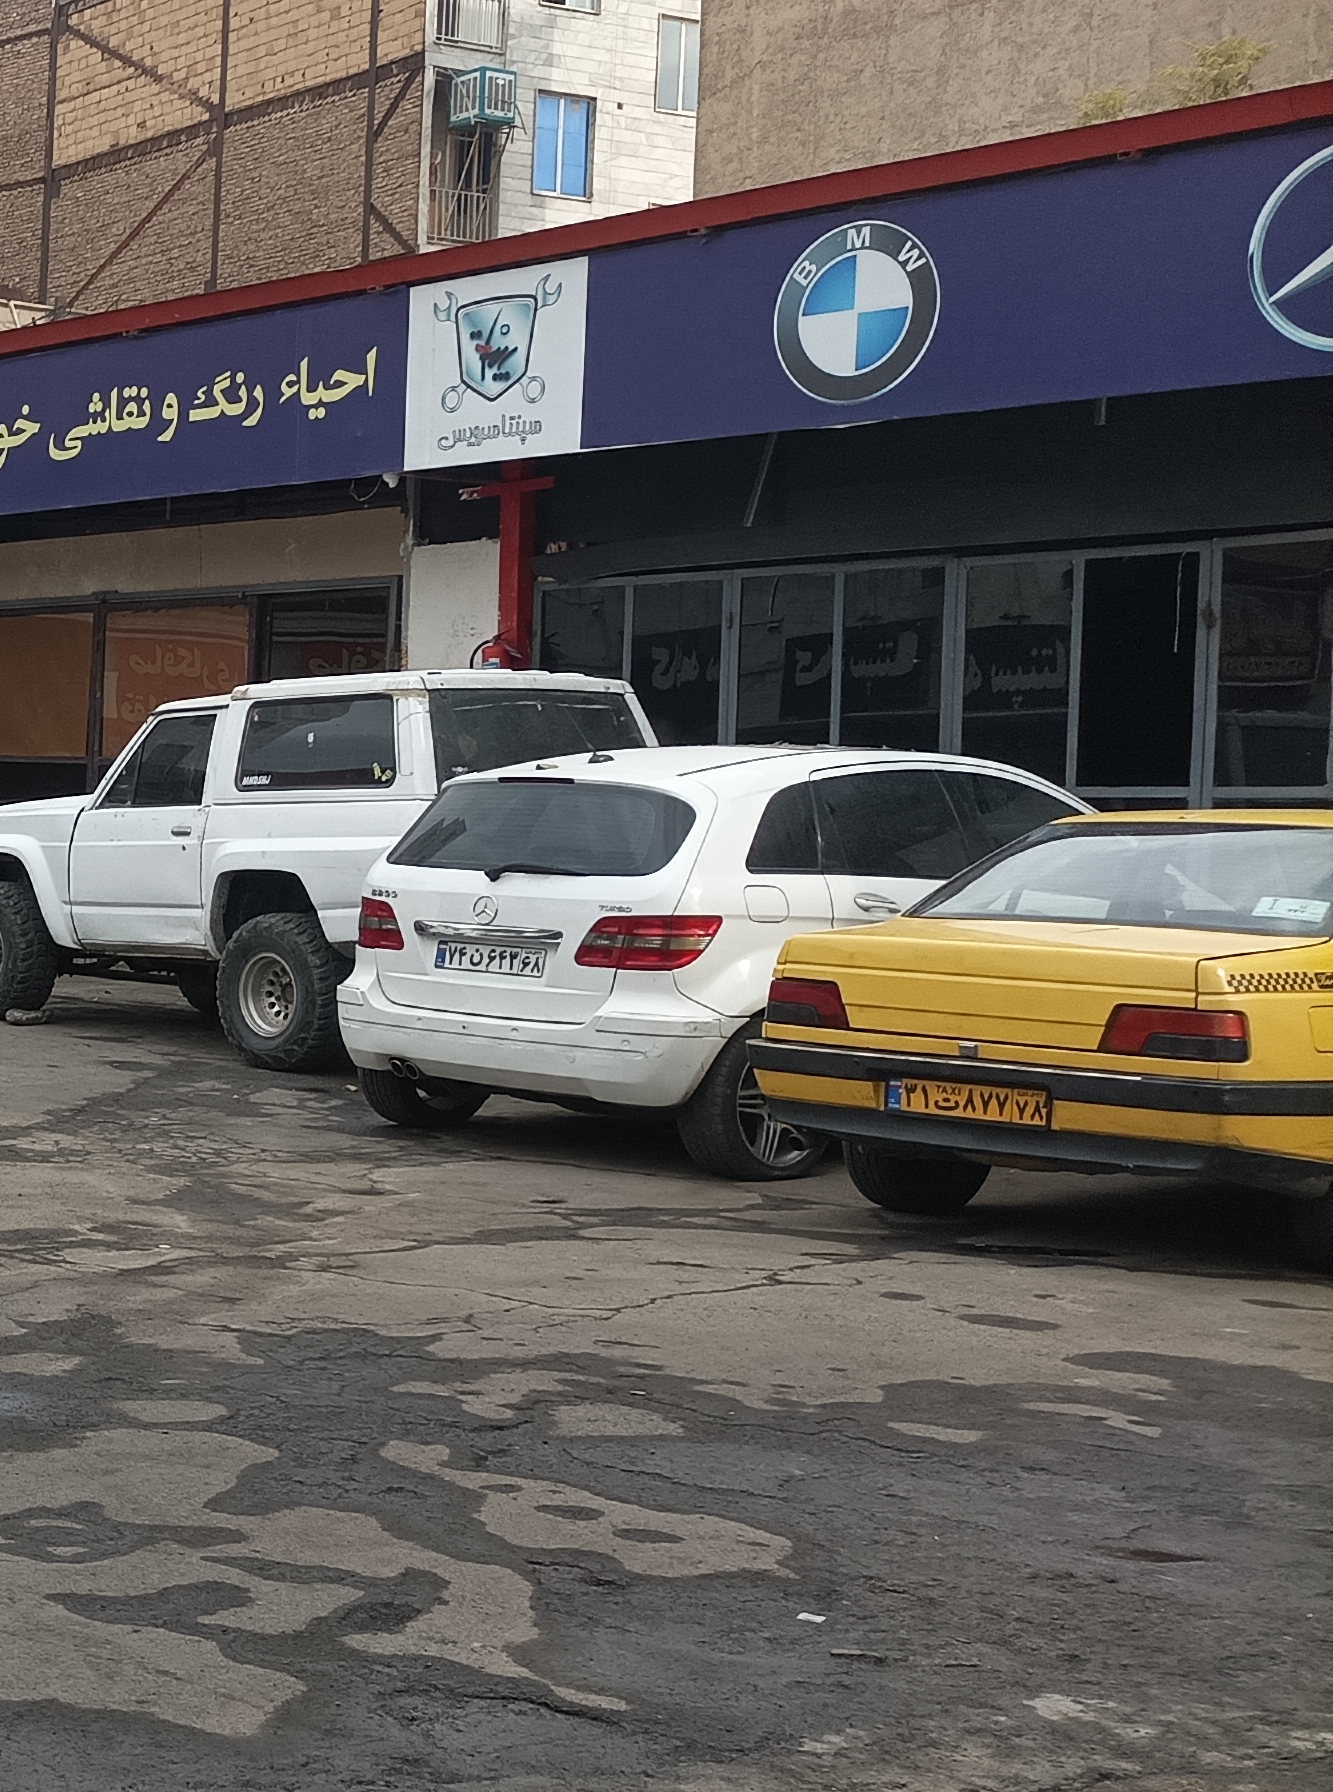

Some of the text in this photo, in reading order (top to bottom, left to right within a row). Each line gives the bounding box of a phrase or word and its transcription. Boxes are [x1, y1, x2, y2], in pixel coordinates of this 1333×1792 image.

[793, 225, 926, 287] BMW
[189, 370, 264, 427] رنگ
[279, 346, 378, 420] احیاء
[48, 385, 152, 461] نقاشی
[156, 391, 180, 441] و
[935, 1084, 961, 1096] TAXI
